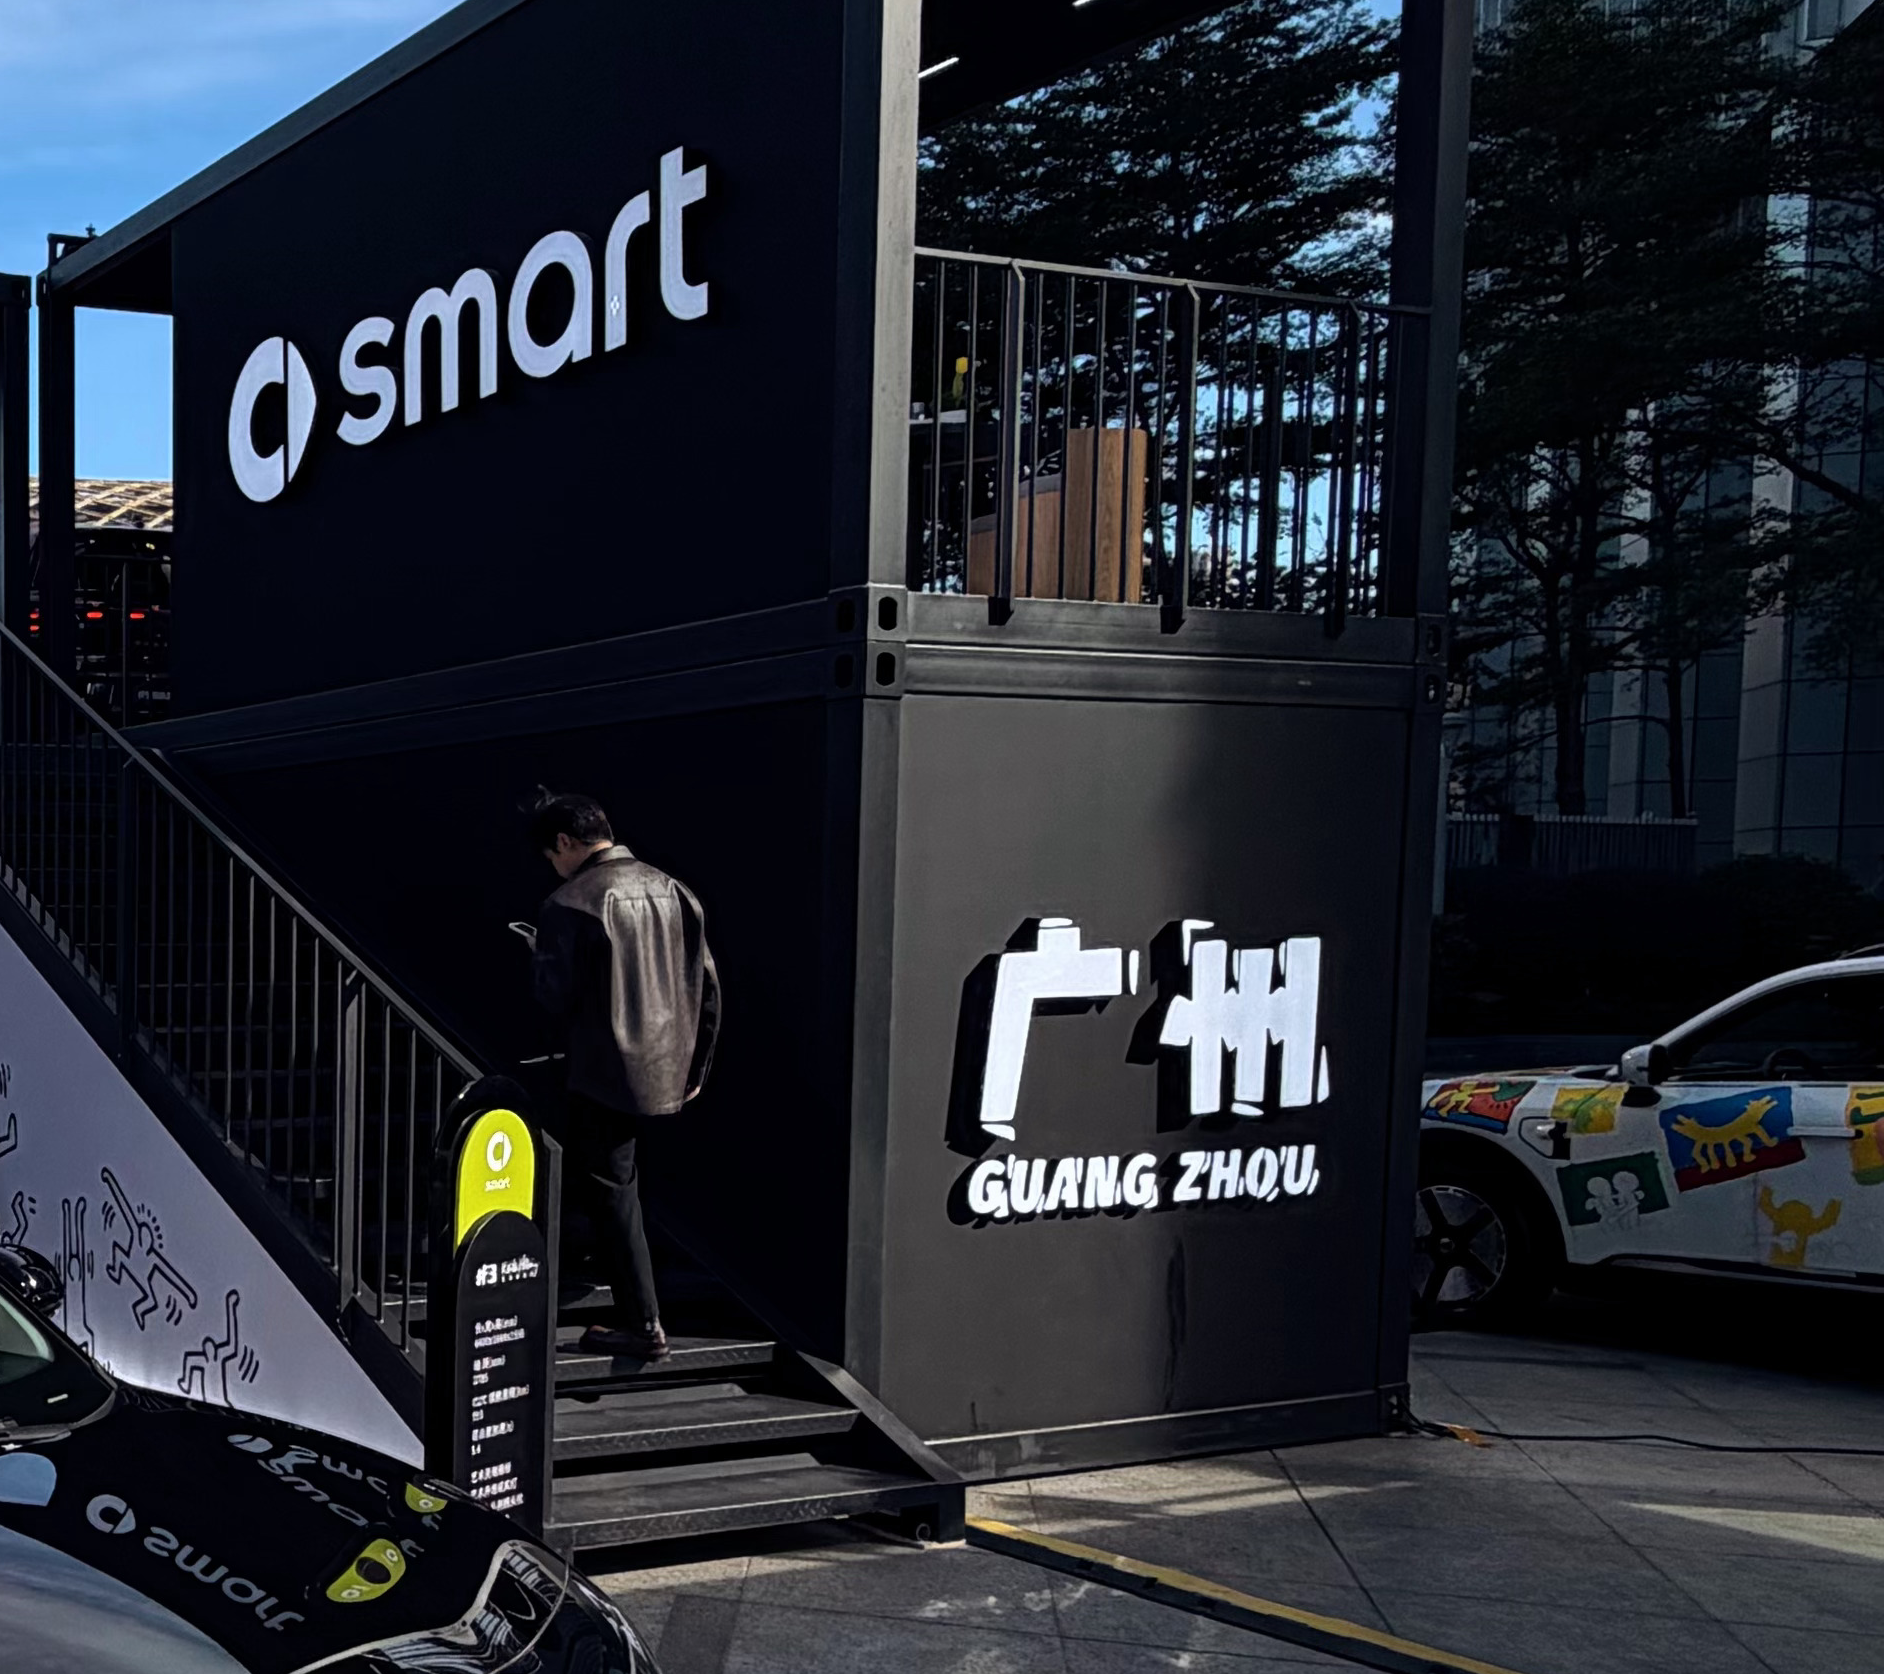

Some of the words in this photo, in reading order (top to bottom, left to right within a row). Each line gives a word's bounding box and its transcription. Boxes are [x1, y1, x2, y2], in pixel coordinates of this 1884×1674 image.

[336, 145, 708, 446] smart
[980, 918, 1329, 1141] 广州
[968, 1152, 1159, 1218] GUANG
[1173, 1144, 1319, 1202] ZHOU
